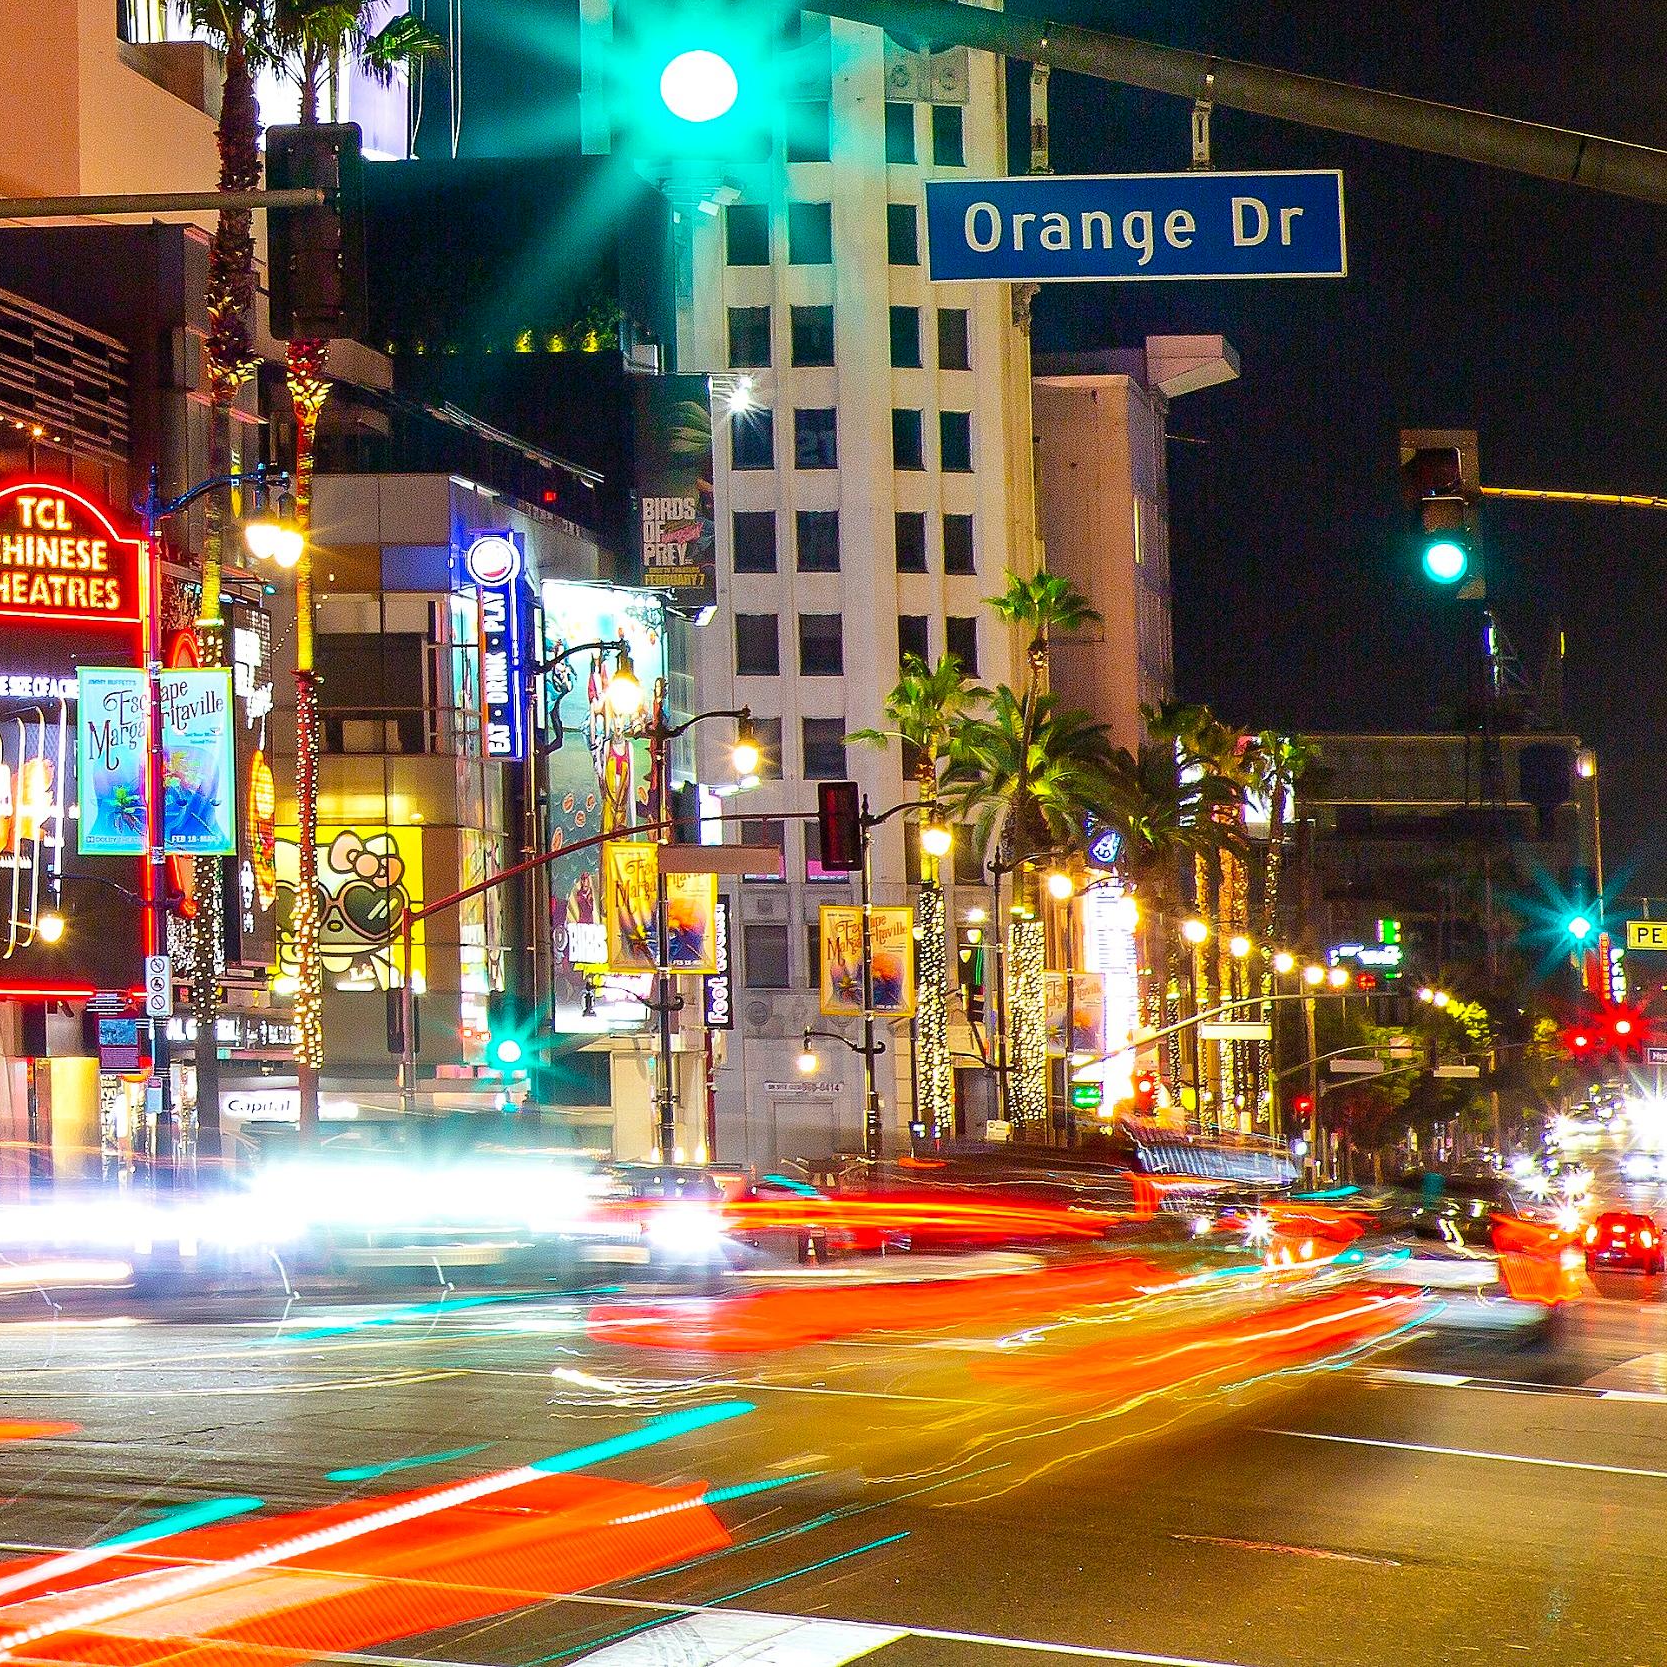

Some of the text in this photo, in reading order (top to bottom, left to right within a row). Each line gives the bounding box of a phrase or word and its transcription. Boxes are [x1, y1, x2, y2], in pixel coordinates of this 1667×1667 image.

[963, 196, 1305, 267] Orange Dr
[16, 495, 73, 532] TCL
[642, 496, 697, 522] BIRDS
[482, 590, 512, 755] EAT DRINK PLAY
[707, 975, 729, 1024] Foot
